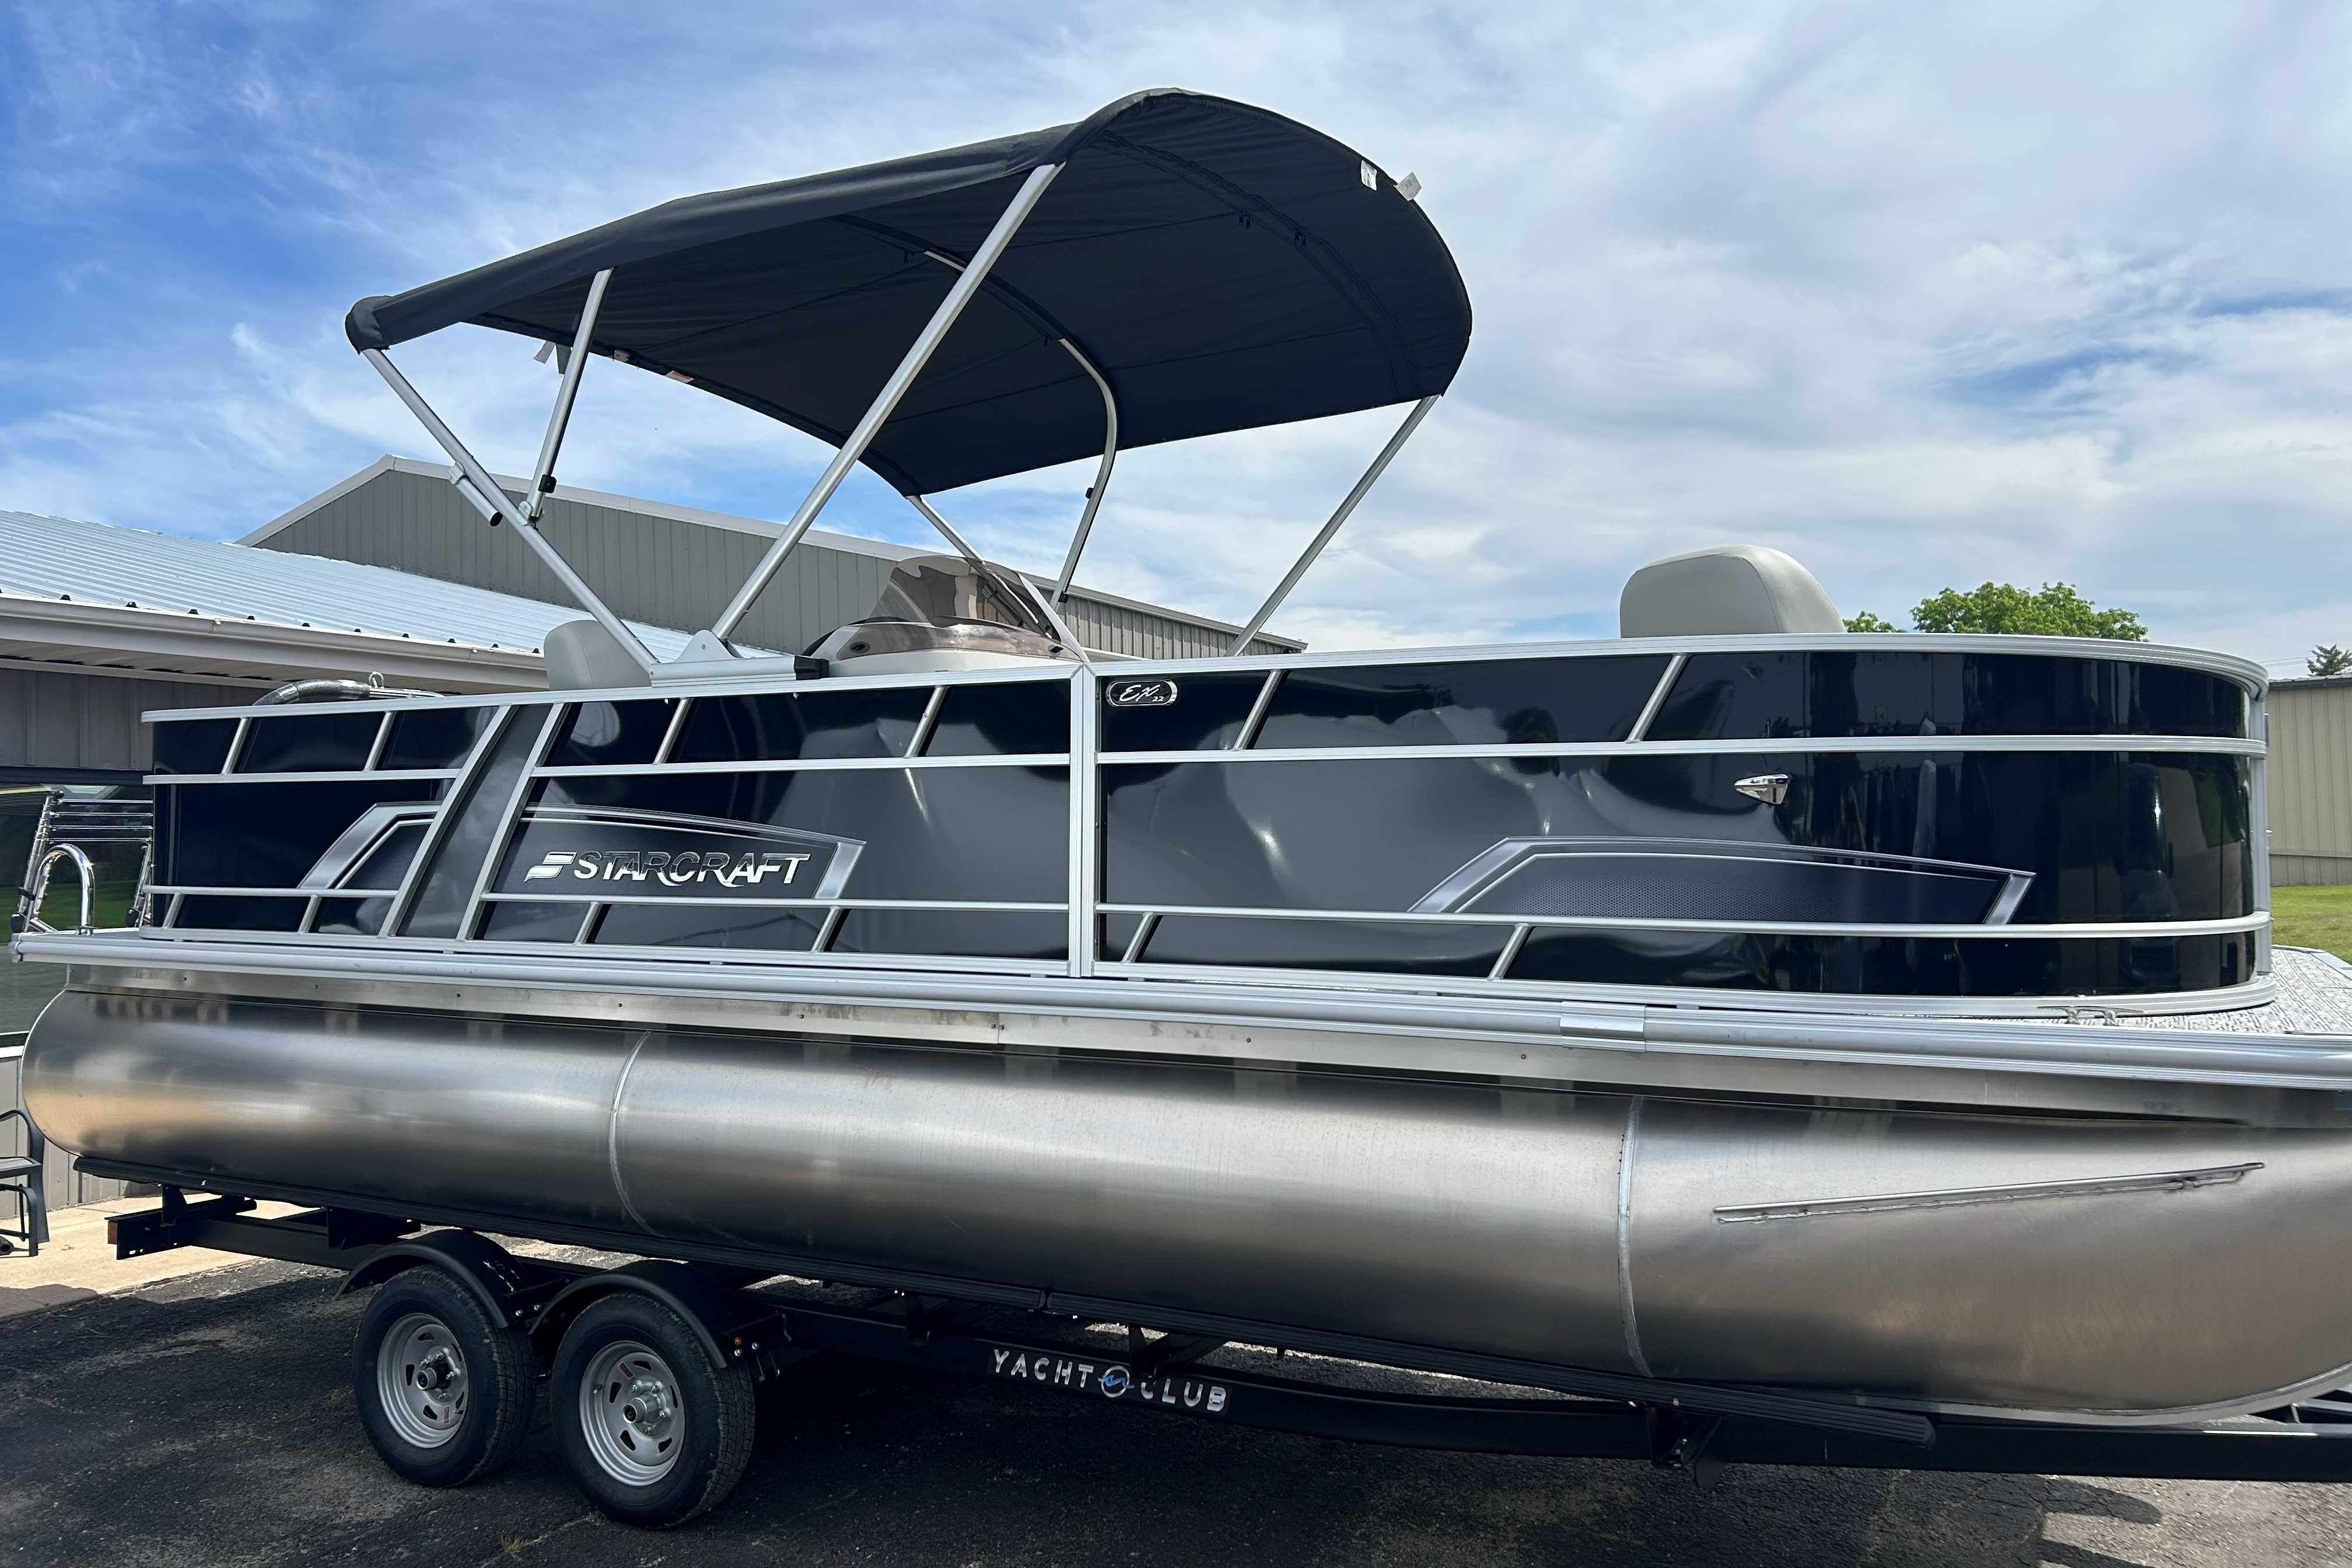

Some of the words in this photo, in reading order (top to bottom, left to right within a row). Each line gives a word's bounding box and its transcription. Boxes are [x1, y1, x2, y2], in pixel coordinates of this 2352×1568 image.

[573, 850, 811, 887] STARCRAFT
[993, 1349, 1094, 1388] YACHT
[1140, 1376, 1227, 1412] CLUB
